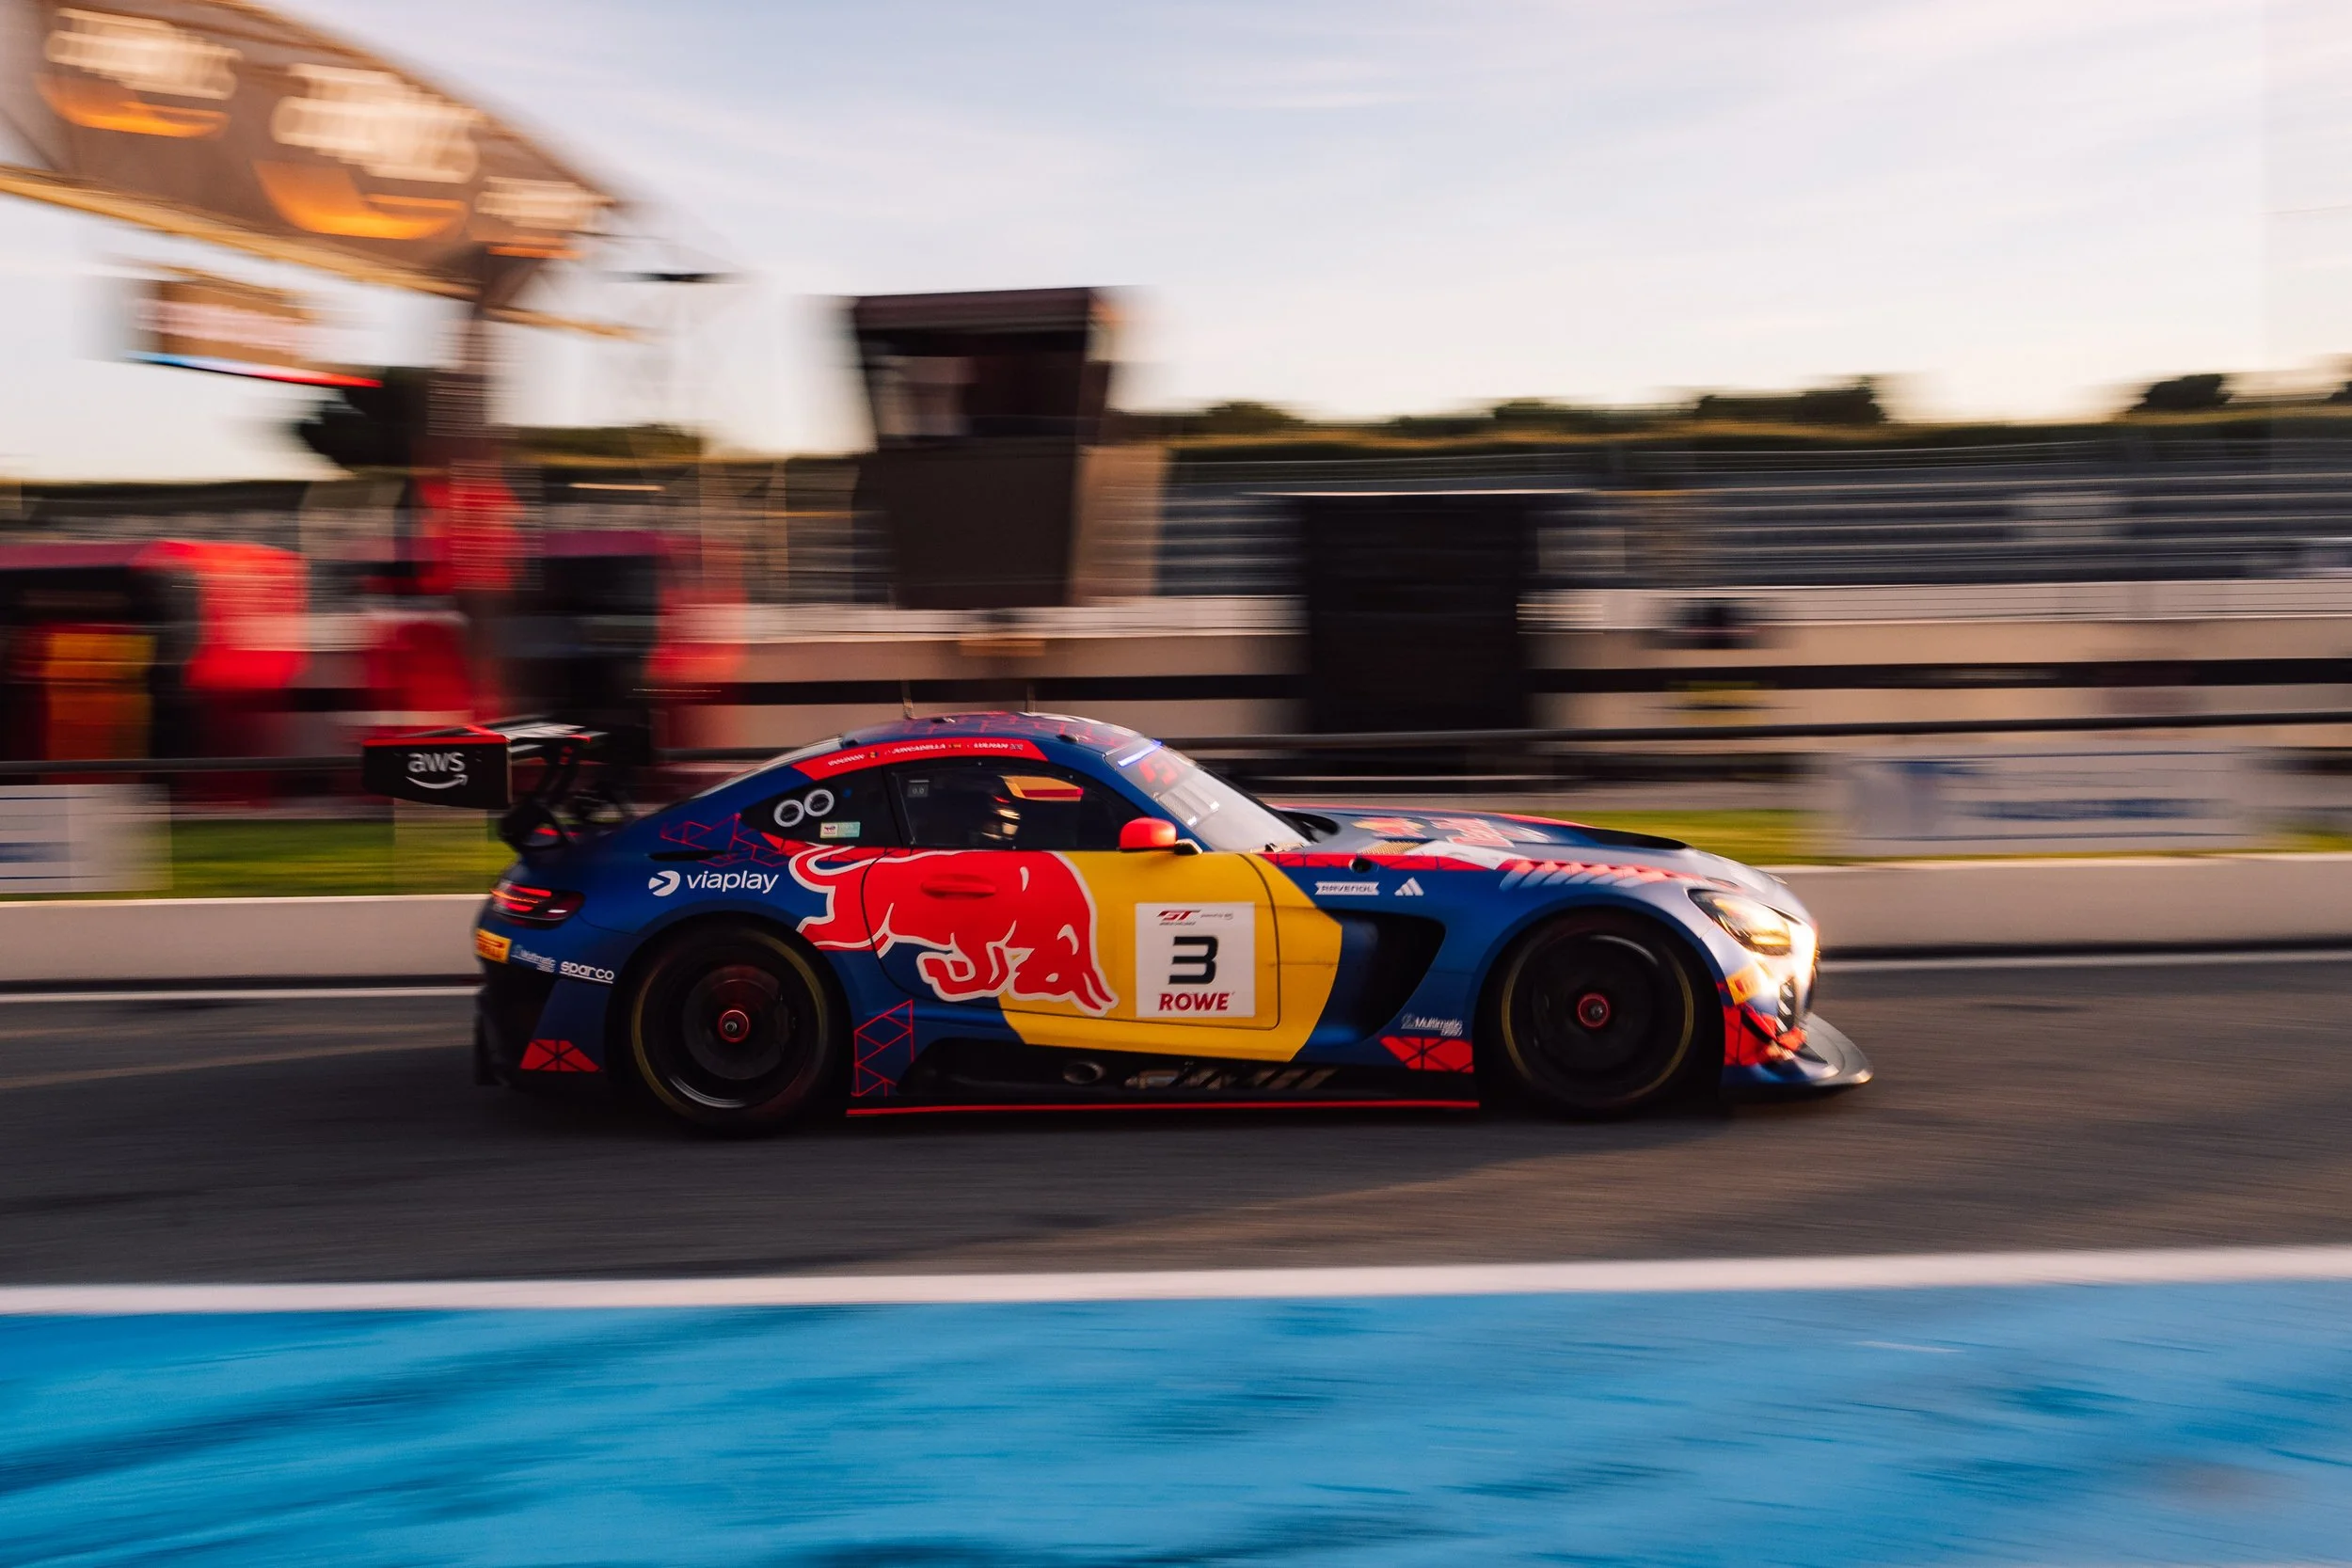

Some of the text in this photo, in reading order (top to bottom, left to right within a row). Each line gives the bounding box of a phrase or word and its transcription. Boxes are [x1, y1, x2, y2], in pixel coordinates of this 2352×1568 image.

[407, 752, 466, 772] aws
[687, 870, 779, 894] viaplay
[560, 960, 614, 981] sparco
[1168, 936, 1218, 985] 3
[1158, 992, 1230, 1011] ROWE
